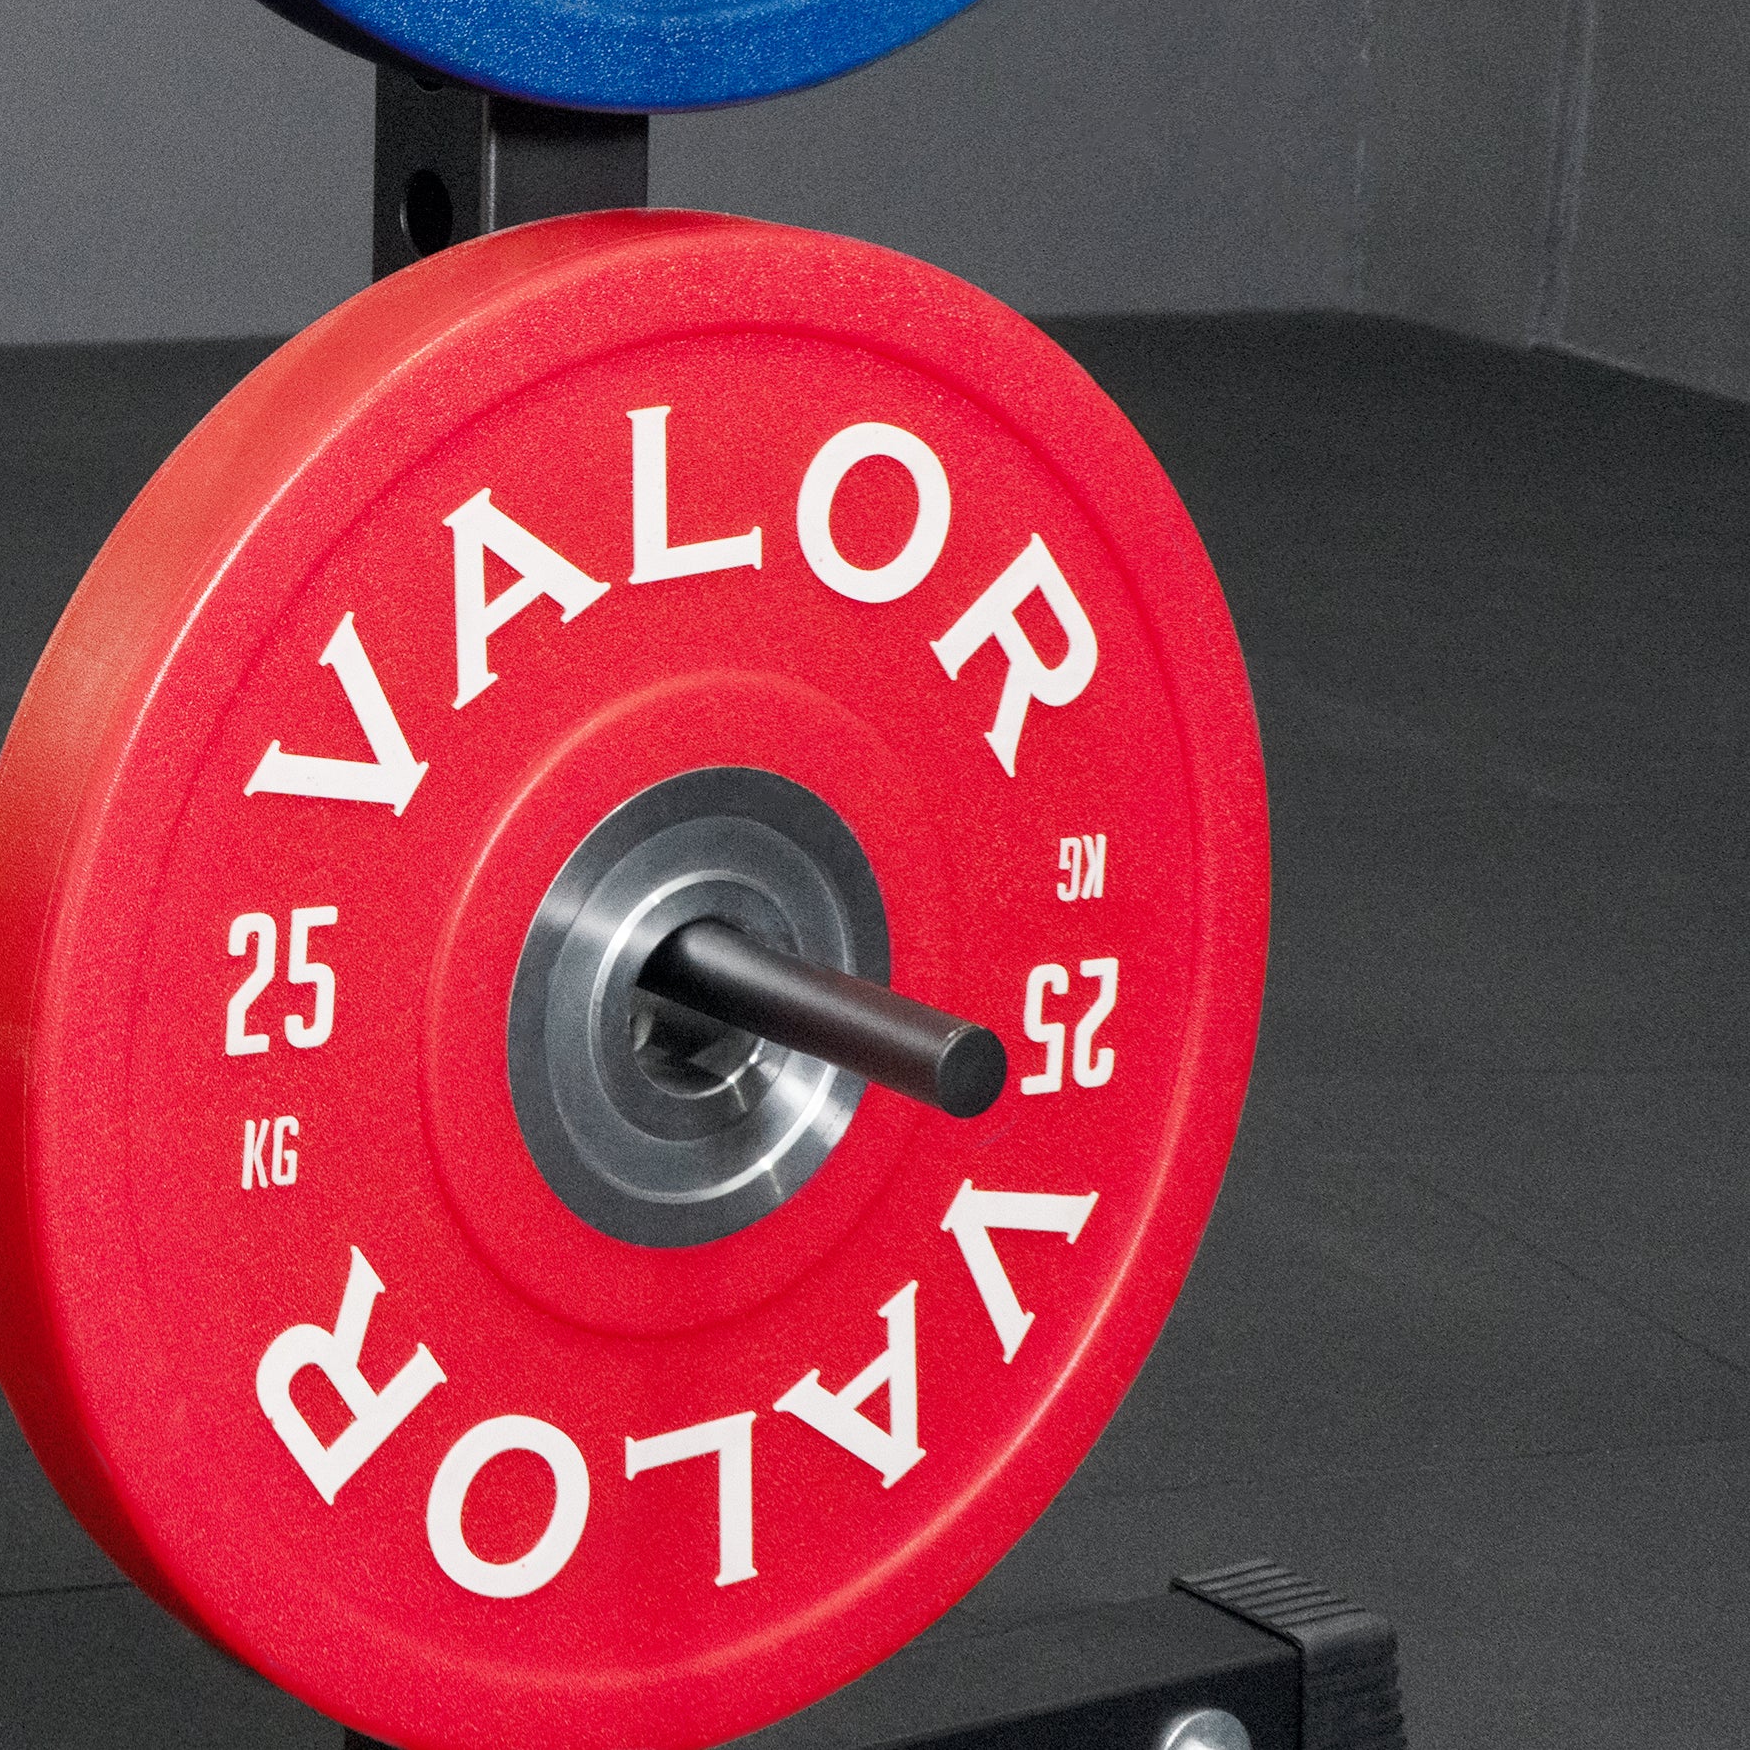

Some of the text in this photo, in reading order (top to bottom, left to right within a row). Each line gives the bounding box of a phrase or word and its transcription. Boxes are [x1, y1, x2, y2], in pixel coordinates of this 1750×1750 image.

[243, 405, 1099, 819] VALOR
[1056, 833, 1107, 902] KG
[224, 906, 339, 1058] 25
[1019, 957, 1120, 1096] 25
[241, 1115, 301, 1191] KG
[255, 1178, 1100, 1599] VALOR
